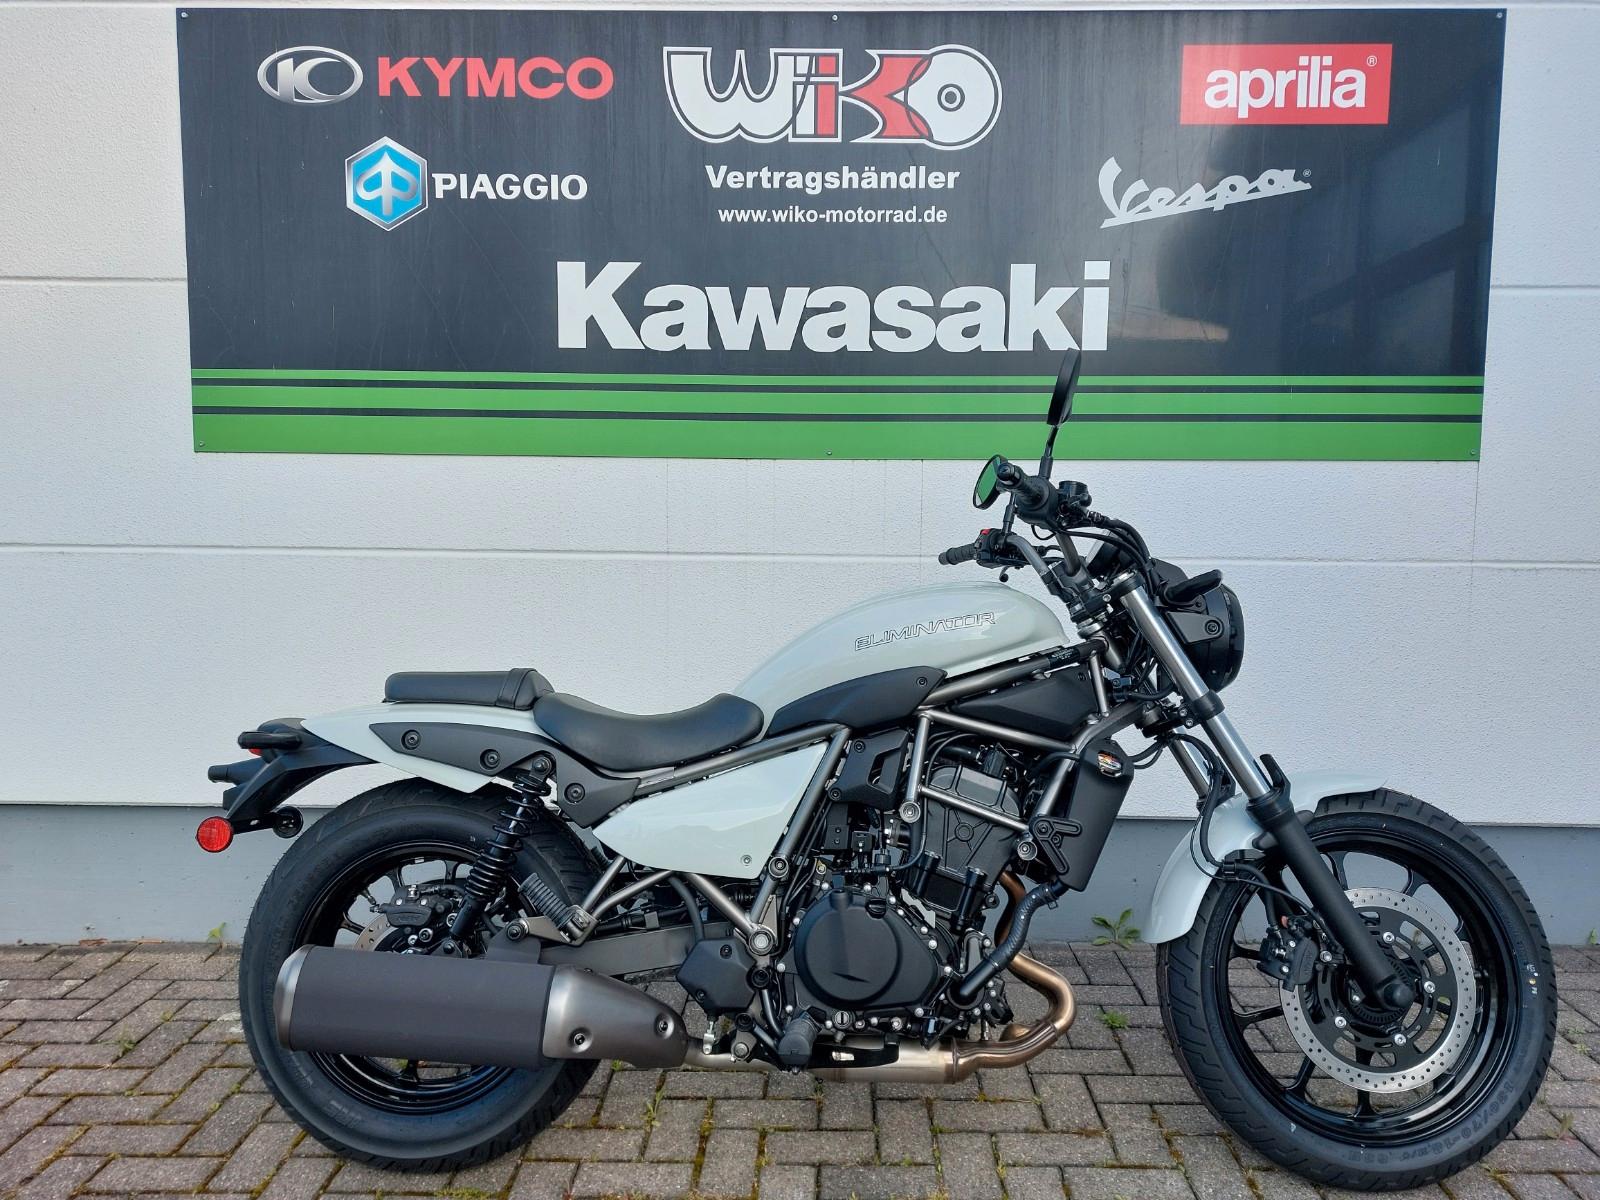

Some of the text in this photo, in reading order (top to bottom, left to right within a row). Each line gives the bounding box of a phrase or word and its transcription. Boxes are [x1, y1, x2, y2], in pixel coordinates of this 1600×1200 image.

[378, 56, 614, 100] KYMCO
[1204, 55, 1367, 118] aprilia
[432, 173, 589, 200] PIAGGIO
[705, 164, 961, 195] Vertragshändler
[1098, 156, 1312, 229] Vespa
[718, 206, 948, 223] www.wiko-motorrad.de
[556, 260, 1111, 353] Kawasaki
[854, 612, 996, 651] ELIMINATOR
